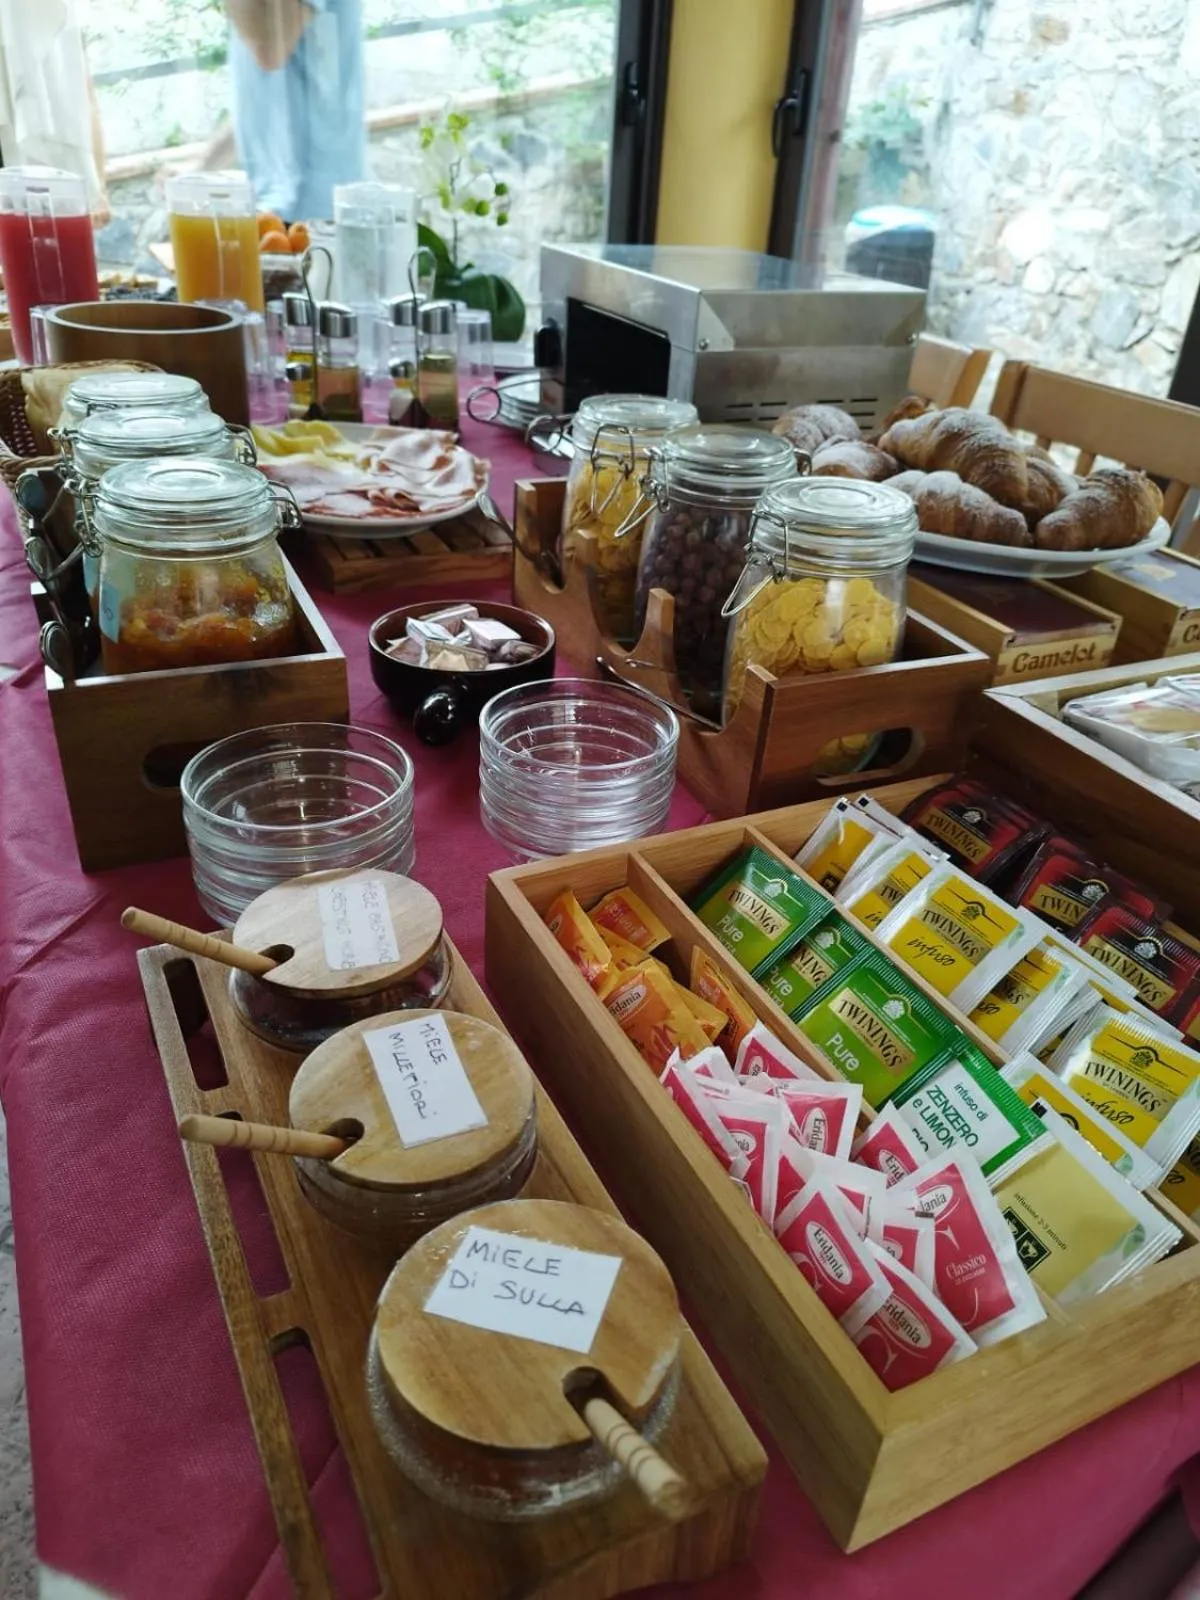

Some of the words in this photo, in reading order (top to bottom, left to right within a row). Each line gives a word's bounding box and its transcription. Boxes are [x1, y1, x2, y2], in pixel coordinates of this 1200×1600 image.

[1012, 642, 1096, 674] Camelot
[926, 814, 981, 859] TWININGS
[728, 889, 781, 935] TWININGS
[1040, 893, 1085, 920] TWIN
[716, 914, 744, 943] Pure
[921, 908, 979, 958] TWININGS
[906, 936, 956, 967] infuso
[1090, 945, 1162, 1002] TWININGS
[825, 1031, 860, 1072] Pure
[838, 999, 902, 1068] TWININGS
[953, 1082, 979, 1112] infuso
[976, 1110, 989, 1122] di
[1084, 1061, 1161, 1113] TWININGS
[808, 1117, 825, 1154] Erida
[911, 1097, 923, 1109] e
[919, 1106, 958, 1150] LIMON
[926, 1084, 979, 1148] ZENZERO
[885, 1155, 905, 1182] Erid
[813, 1227, 845, 1280] Eridania
[945, 1253, 987, 1280] Classico
[493, 1279, 585, 1315] SULLA
